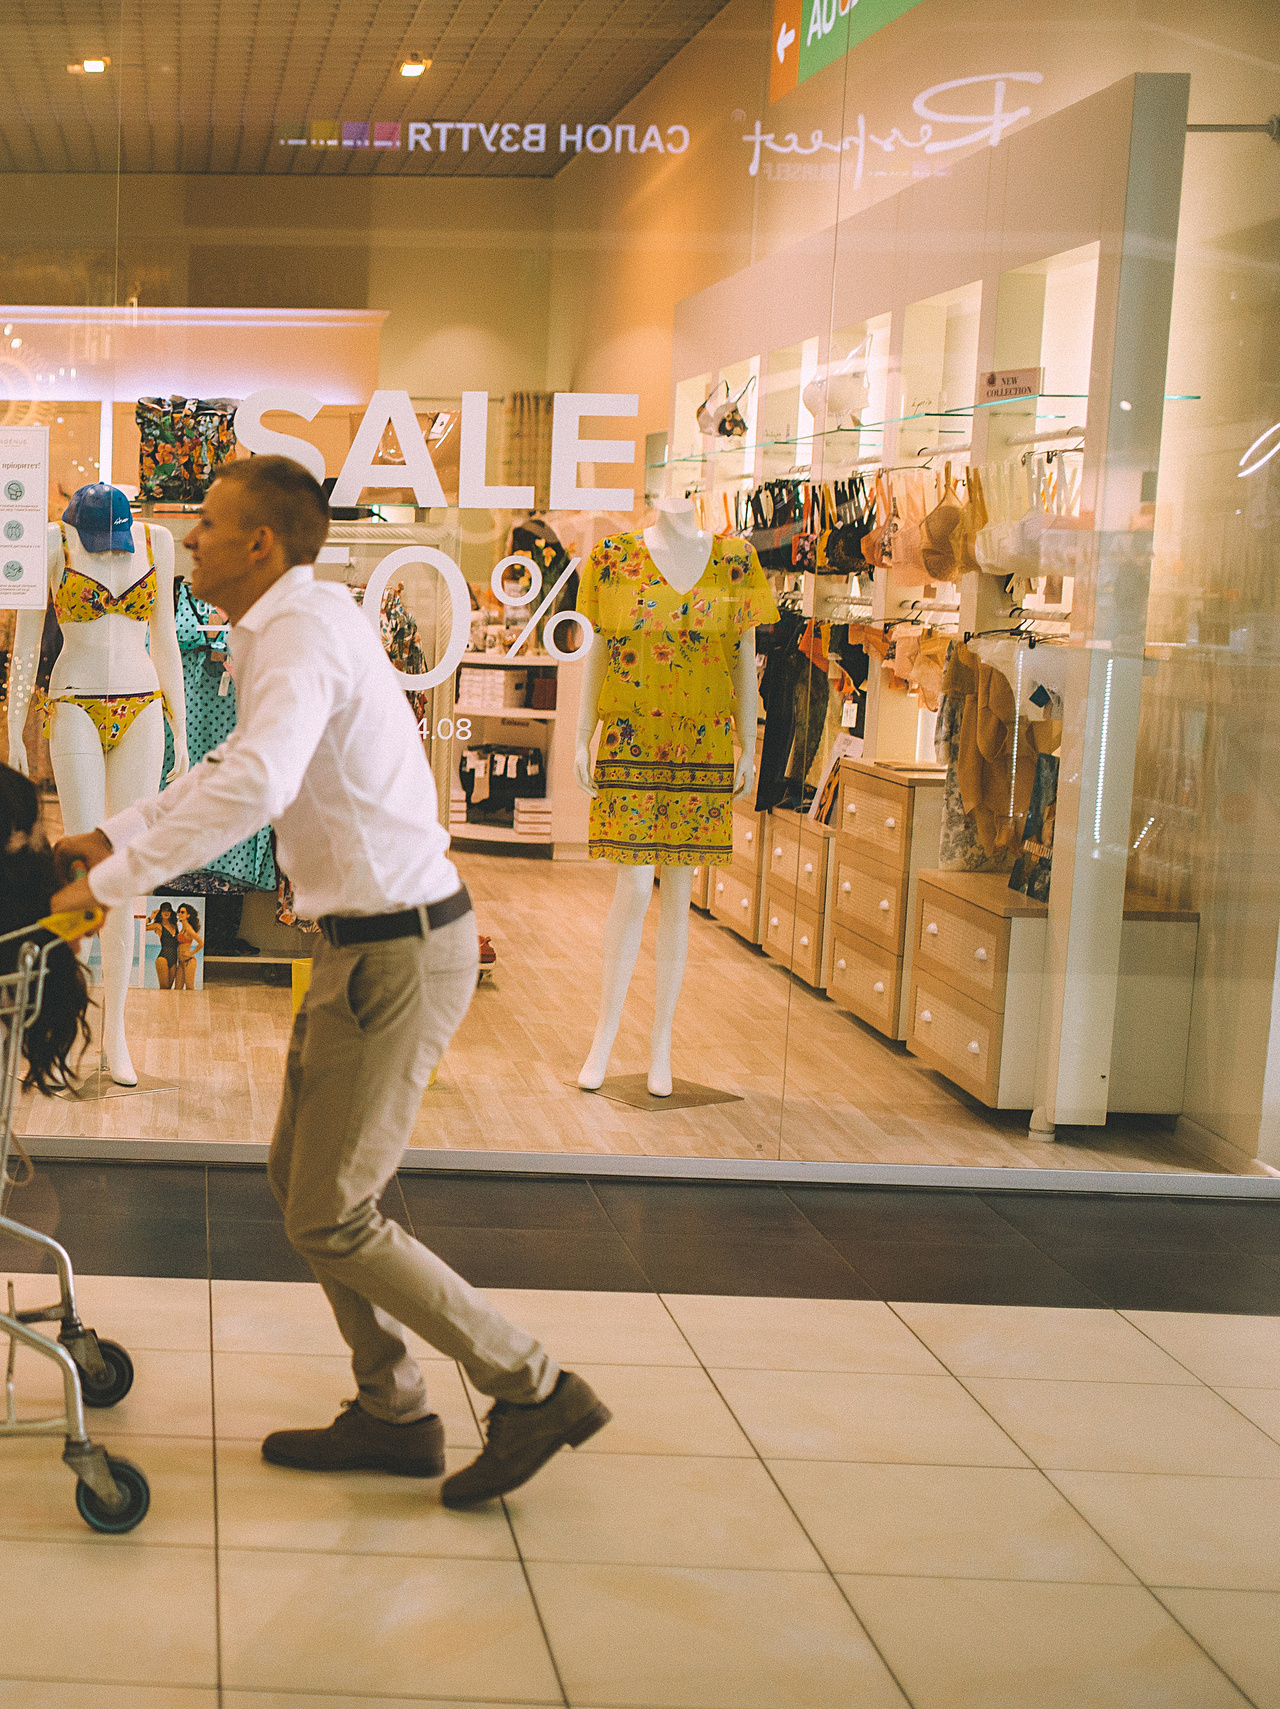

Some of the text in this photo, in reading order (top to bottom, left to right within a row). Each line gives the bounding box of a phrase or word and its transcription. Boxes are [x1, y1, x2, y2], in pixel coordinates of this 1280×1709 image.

[1000, 376, 1019, 385] NEW
[986, 386, 1033, 398] COLLECTION
[233, 387, 640, 512] SALE
